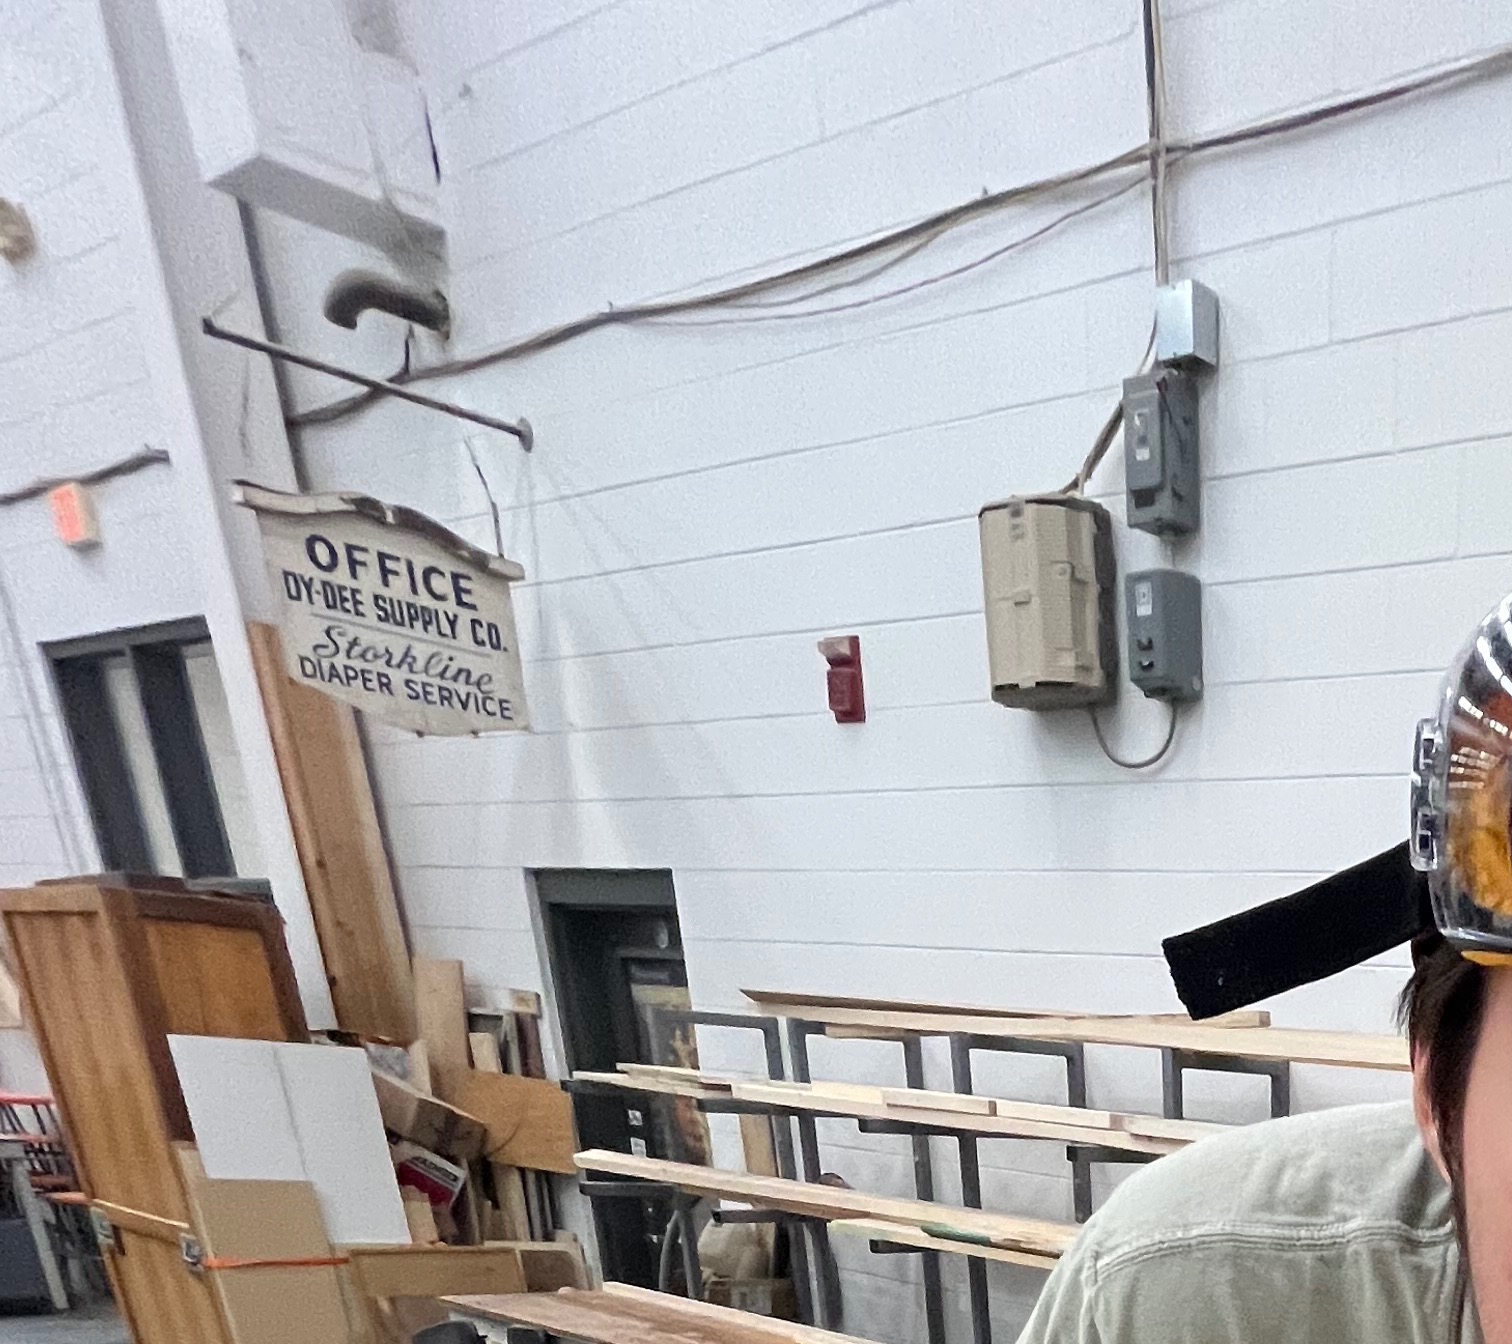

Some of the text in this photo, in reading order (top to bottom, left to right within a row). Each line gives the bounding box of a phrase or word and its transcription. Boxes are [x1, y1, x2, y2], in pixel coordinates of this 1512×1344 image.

[305, 534, 478, 611] OFFICE
[282, 569, 509, 652] DY-DEE SUPPLY CO.
[298, 654, 514, 720] DIAPER SERVICE
[312, 625, 494, 695] Storkline
